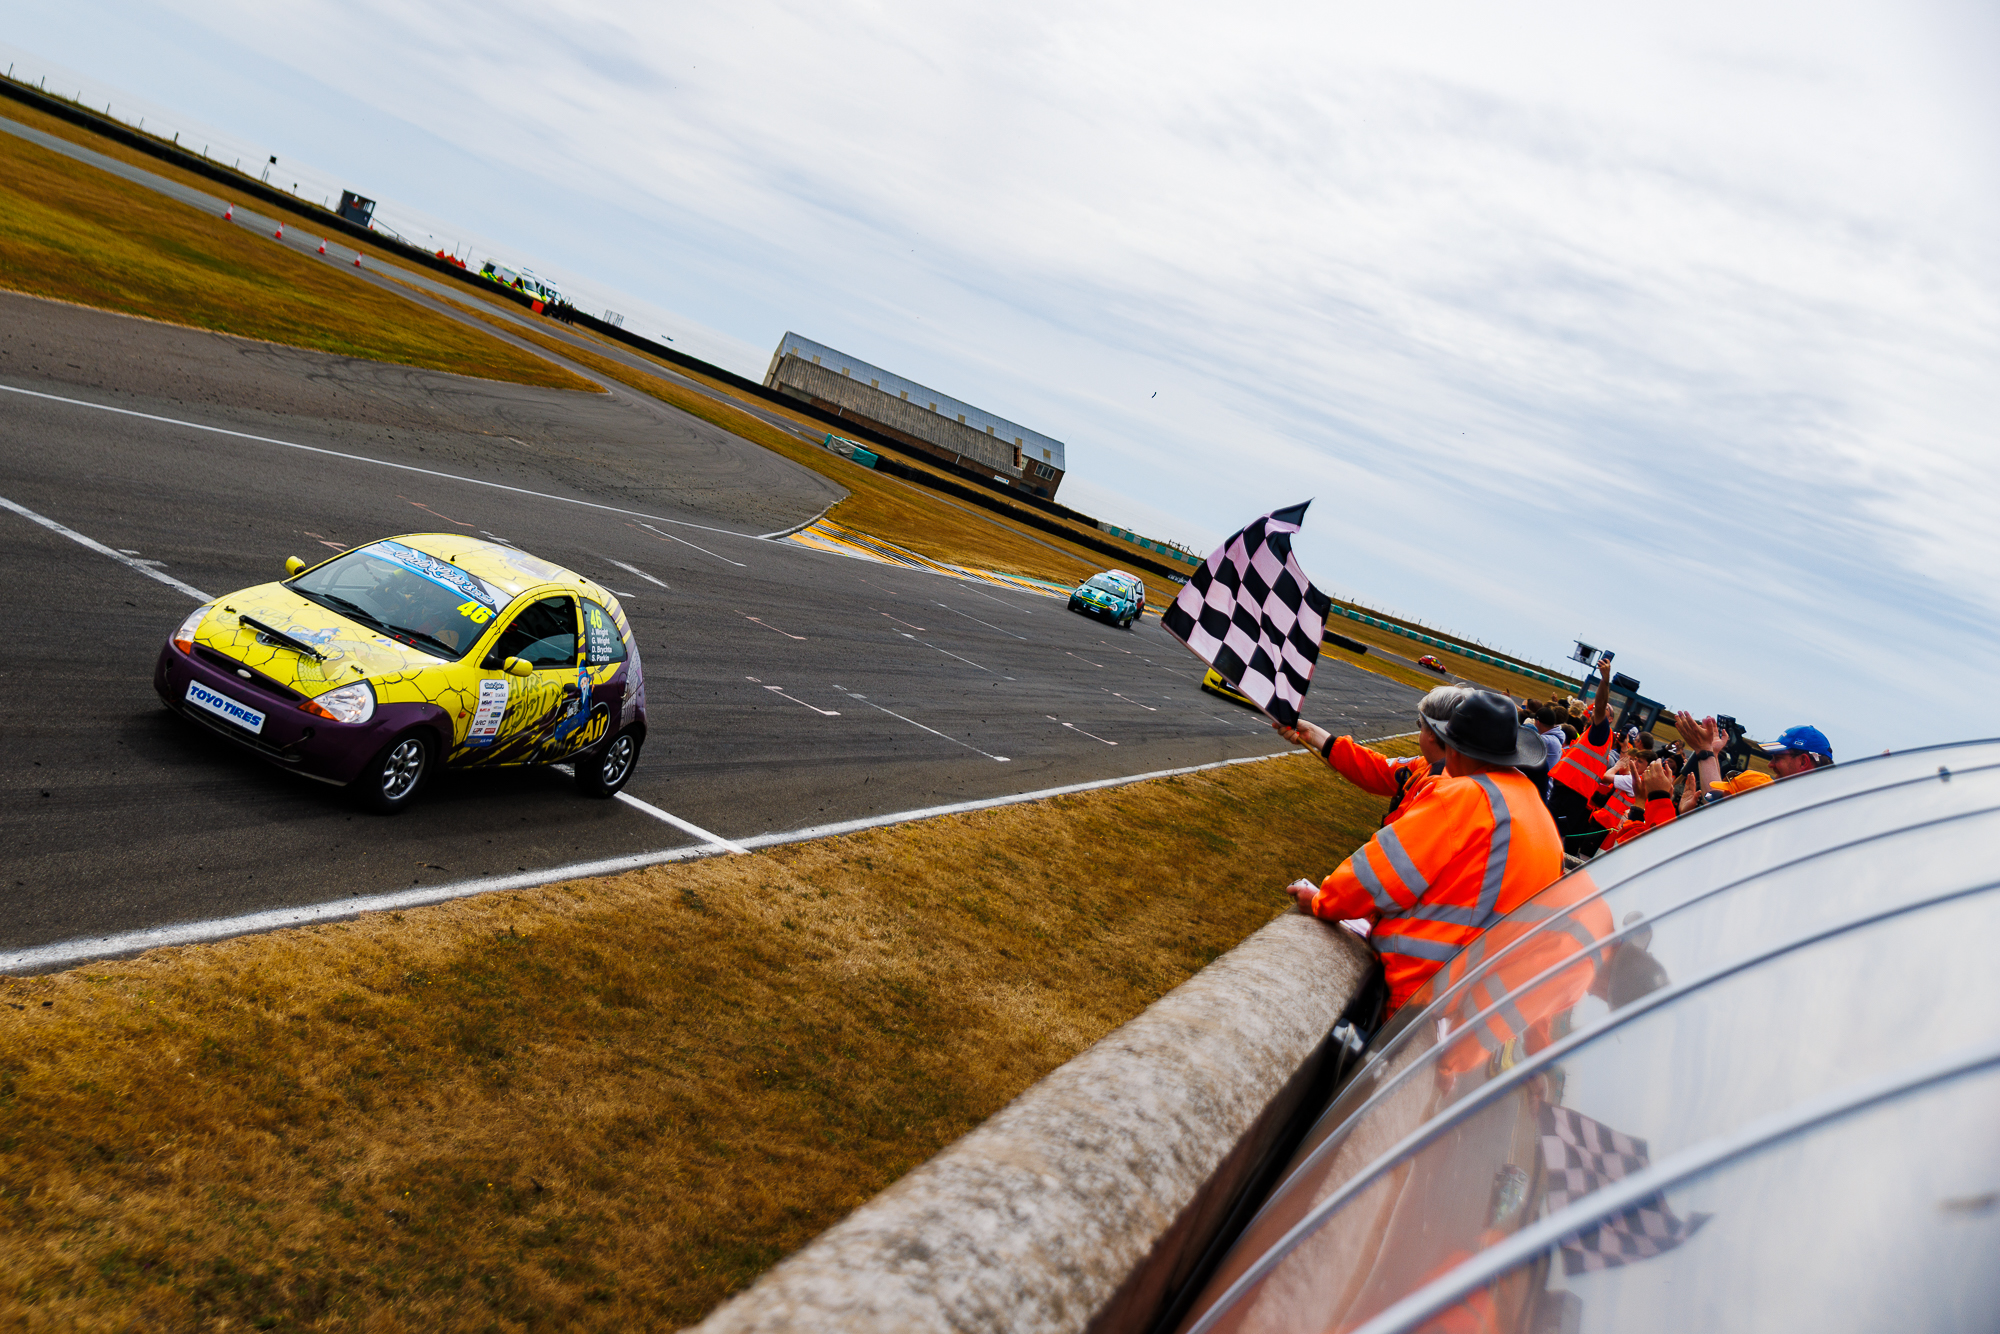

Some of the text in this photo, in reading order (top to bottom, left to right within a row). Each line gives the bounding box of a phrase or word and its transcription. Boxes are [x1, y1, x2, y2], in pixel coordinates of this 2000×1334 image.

[457, 601, 492, 624] 46
[590, 609, 602, 629] 46
[591, 628, 609, 637] J. Wright
[591, 636, 610, 646] G. Wright
[591, 645, 596, 653] D.
[591, 654, 610, 662] S. Parkin
[190, 685, 262, 727] TOYO TIRES
